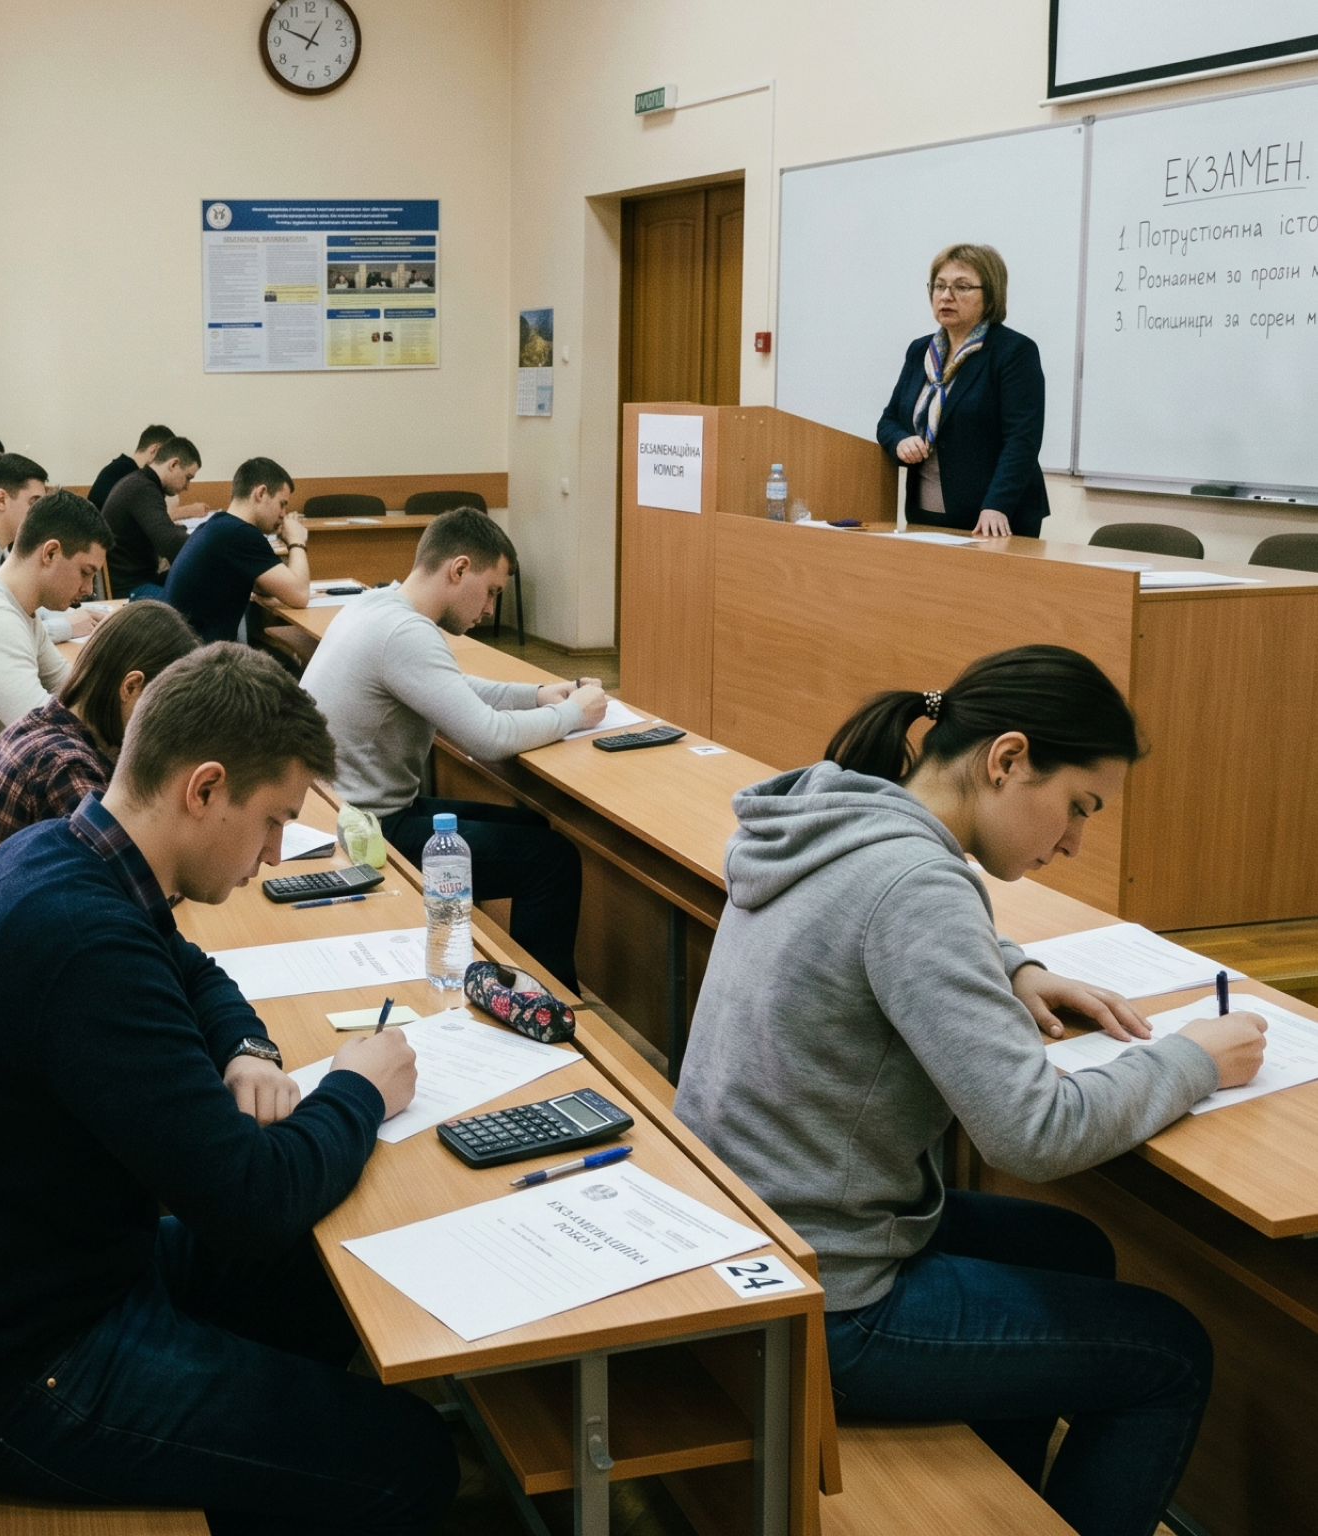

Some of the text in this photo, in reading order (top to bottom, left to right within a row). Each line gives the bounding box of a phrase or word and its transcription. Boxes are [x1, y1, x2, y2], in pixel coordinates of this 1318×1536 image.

[290, 6, 298, 18] 11
[305, 1, 316, 13] 12
[325, 7, 329, 18] 1
[279, 19, 290, 31] 10
[335, 19, 343, 31] 2
[273, 36, 281, 47] 9
[340, 36, 347, 47] 3
[279, 53, 287, 65] 8
[335, 54, 342, 64] 4
[291, 65, 299, 77] 7
[307, 70, 315, 82] 6
[323, 65, 331, 77] 5
[1165, 141, 1310, 198] ЕКЗАМЕН.
[726, 1262, 785, 1290] 24
